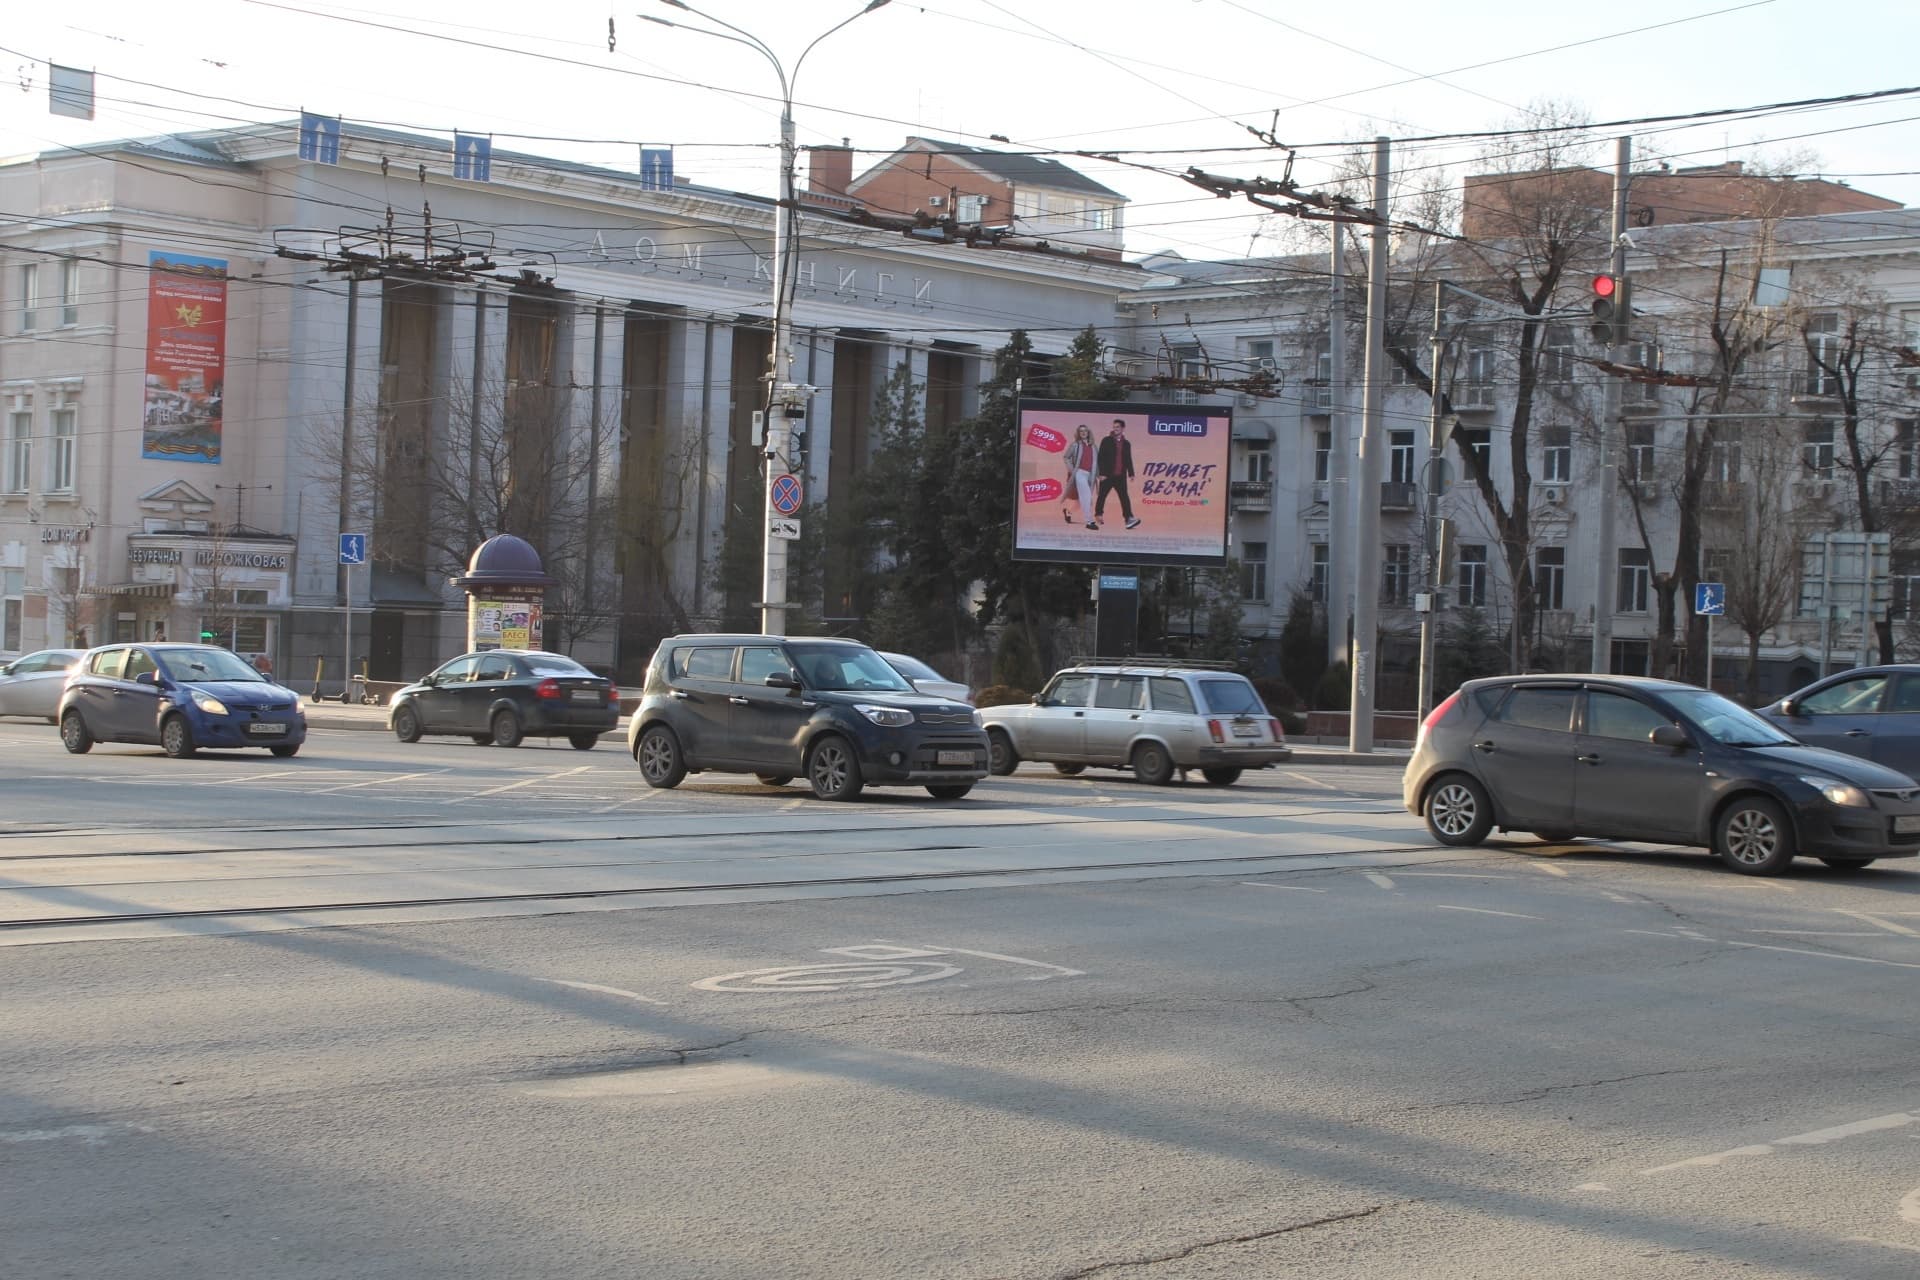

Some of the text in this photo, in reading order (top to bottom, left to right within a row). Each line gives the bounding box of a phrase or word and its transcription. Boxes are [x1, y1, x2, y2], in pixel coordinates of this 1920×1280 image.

[587, 230, 932, 304] ДОМ КНИГИ
[1155, 419, 1202, 433] familia
[196, 551, 286, 568] ПИРОЖКОВАЯ
